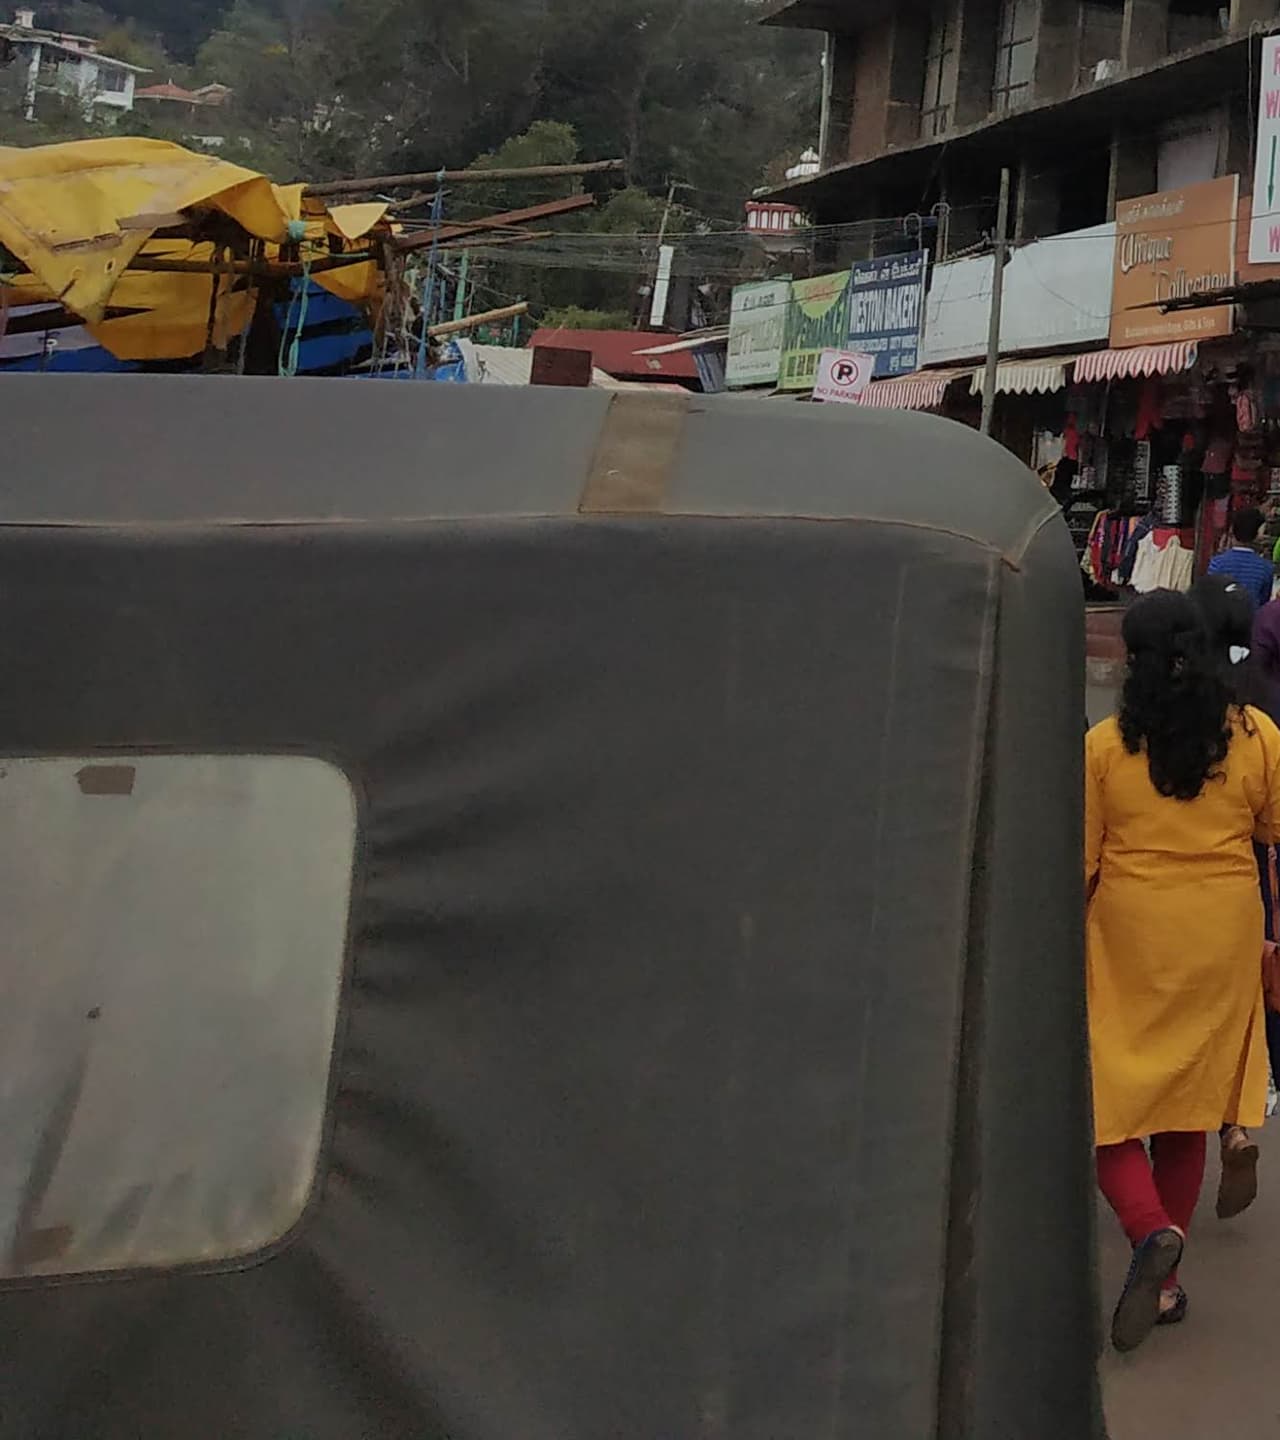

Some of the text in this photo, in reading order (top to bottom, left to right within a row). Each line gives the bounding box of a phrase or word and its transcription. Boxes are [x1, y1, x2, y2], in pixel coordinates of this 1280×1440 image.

[1118, 232, 1175, 276] Unique
[849, 289, 884, 334] WESTON
[884, 283, 922, 331] BAKERY
